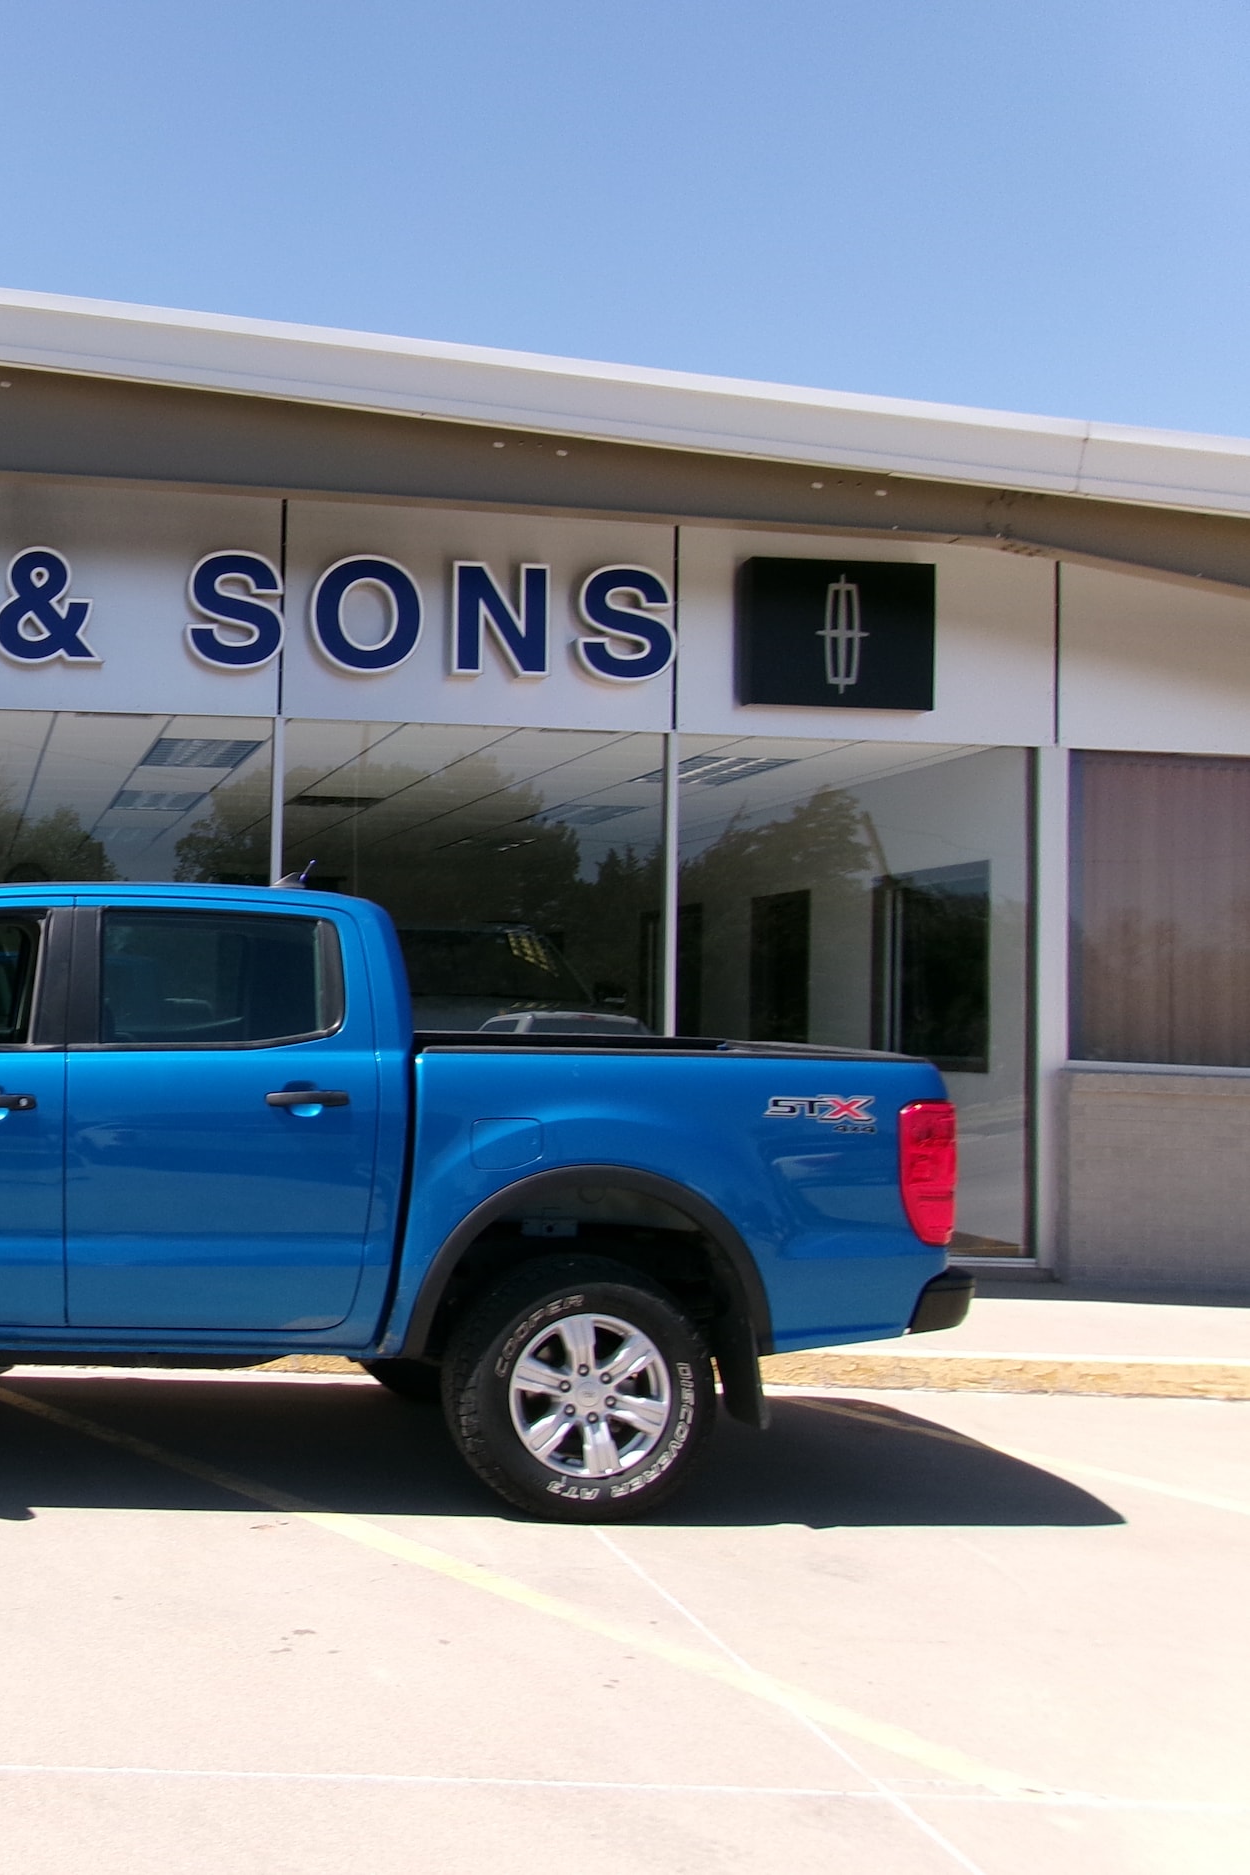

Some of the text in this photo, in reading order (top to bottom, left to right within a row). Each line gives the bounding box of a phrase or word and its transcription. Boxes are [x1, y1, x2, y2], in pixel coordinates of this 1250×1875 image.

[184, 549, 678, 684] SONS
[762, 1094, 877, 1124] STX
[494, 1294, 585, 1378] COOPER
[609, 1361, 695, 1499] DISCOVERER
